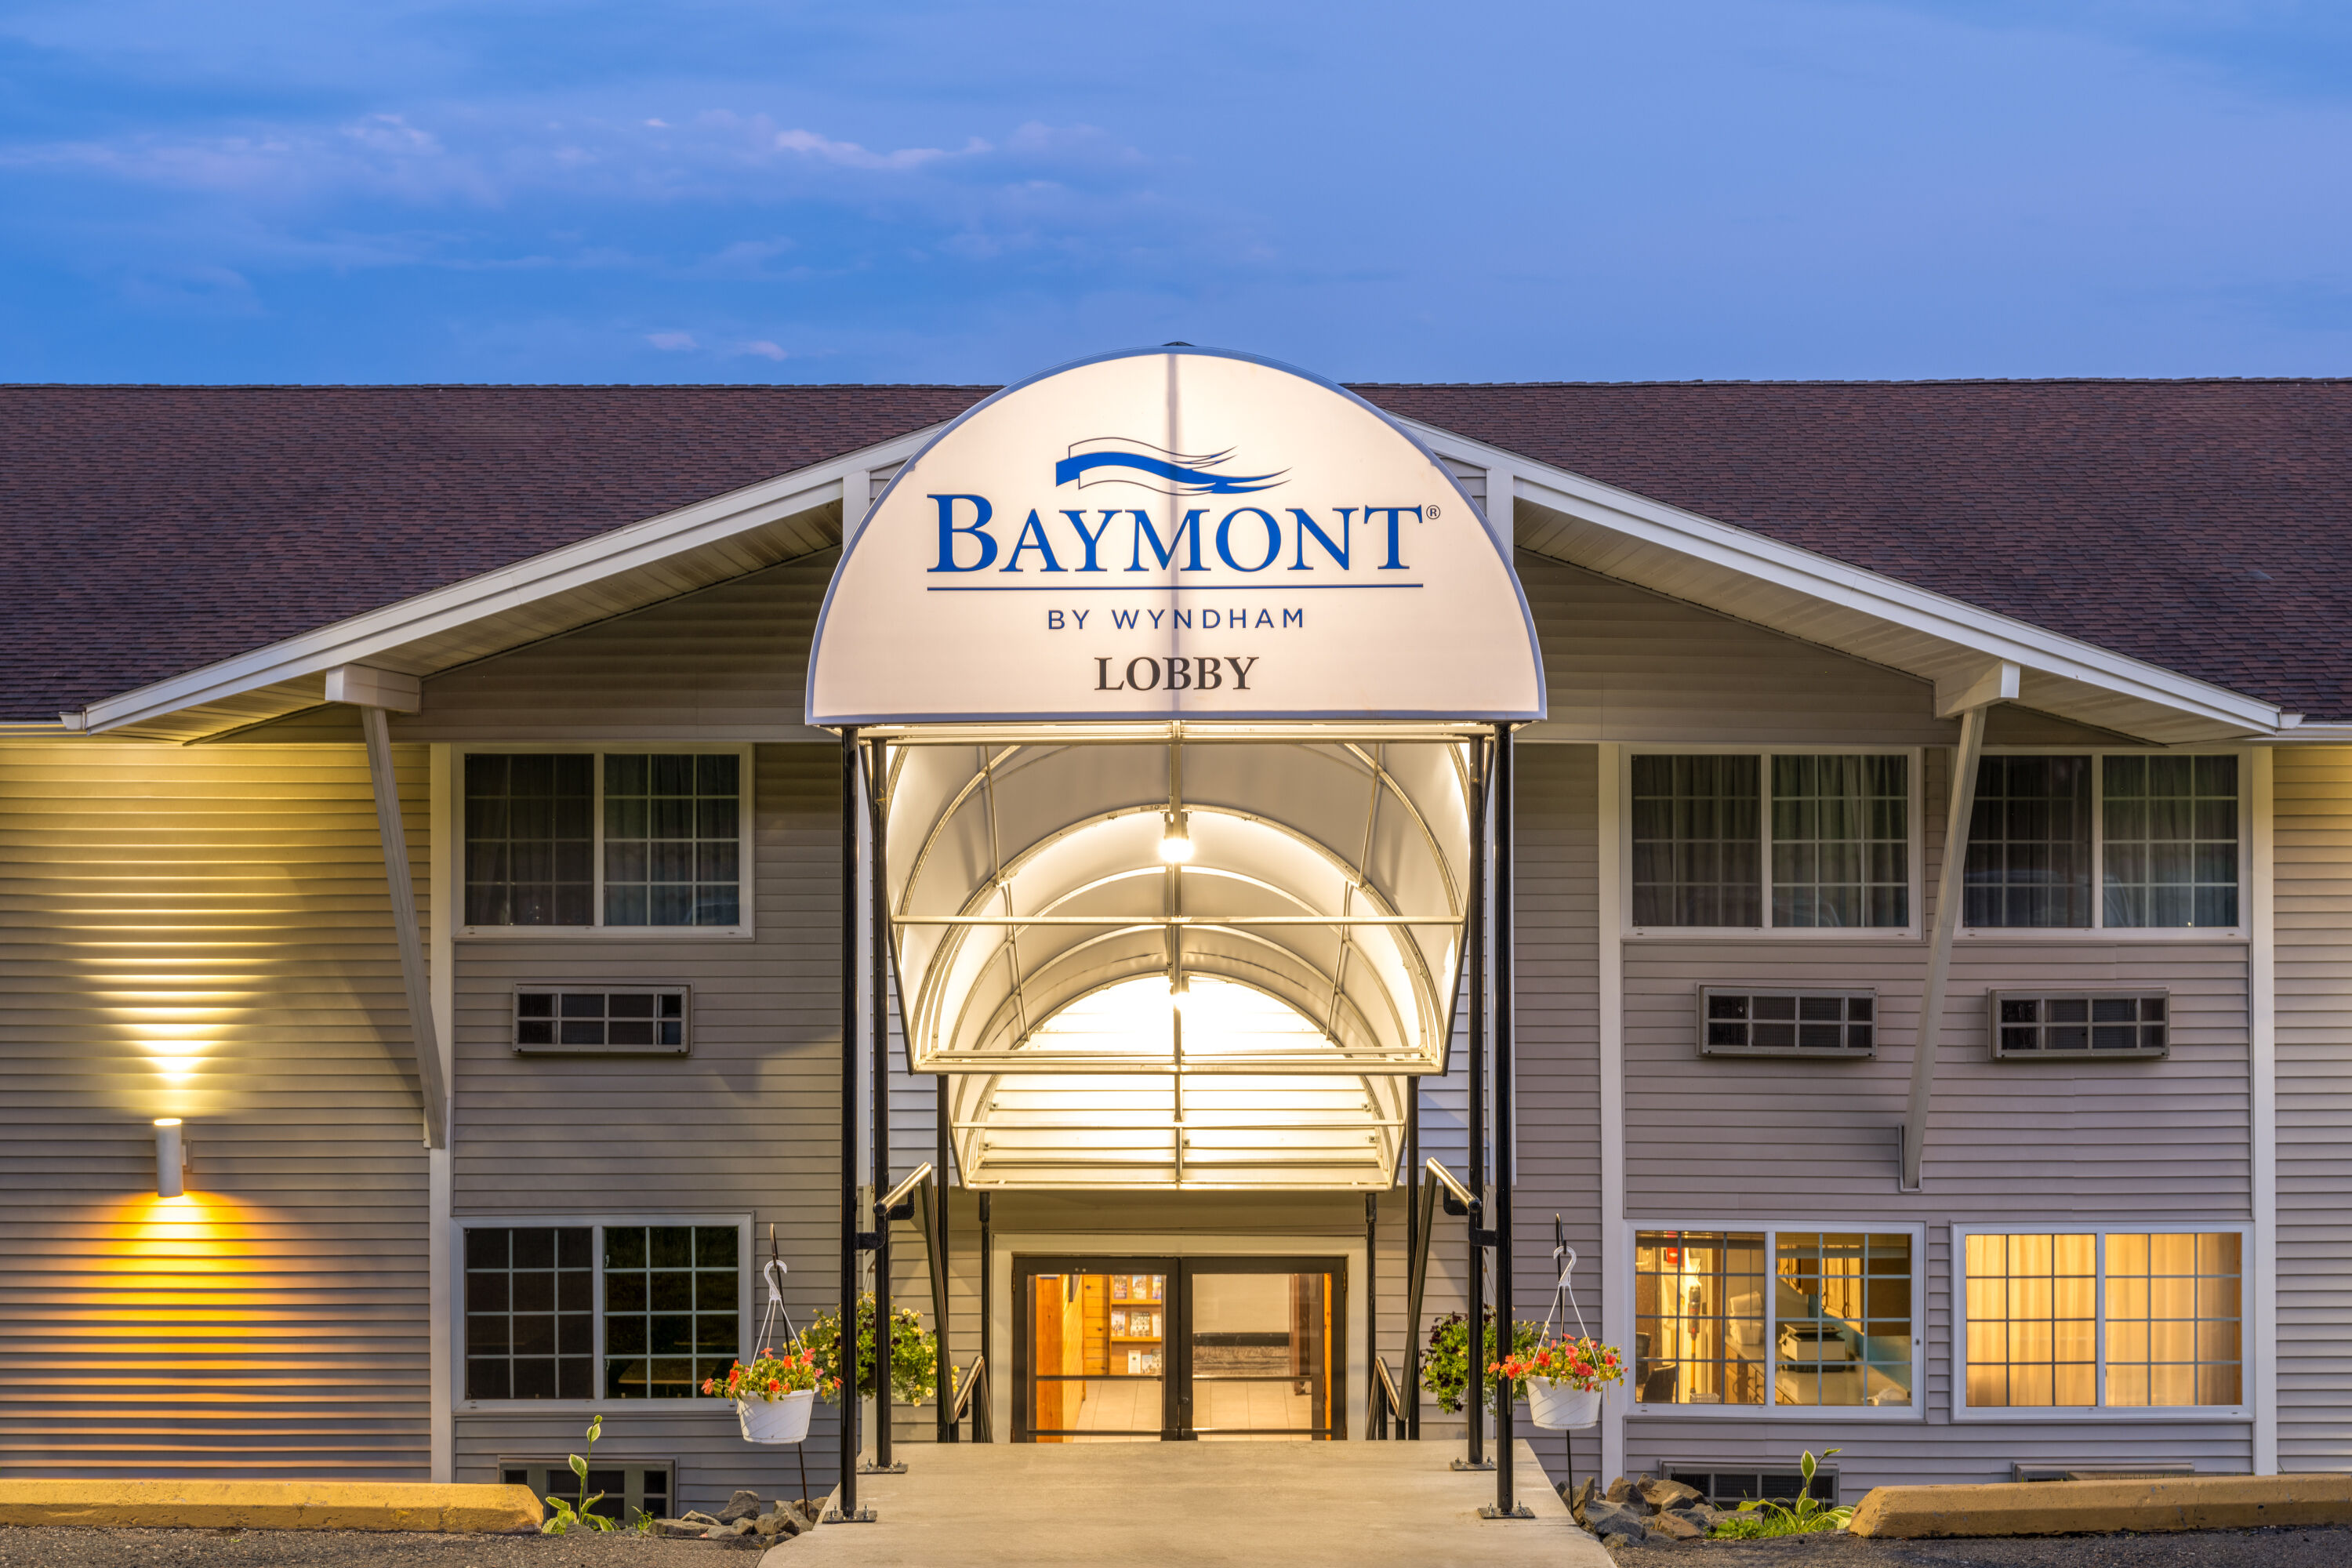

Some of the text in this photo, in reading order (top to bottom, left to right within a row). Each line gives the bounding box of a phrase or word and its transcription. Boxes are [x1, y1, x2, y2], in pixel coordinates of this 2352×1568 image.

[926, 493, 1423, 573] BAYMONT
[1048, 608, 1304, 630] BY WYNDHAM
[1094, 656, 1260, 691] LOBBY
